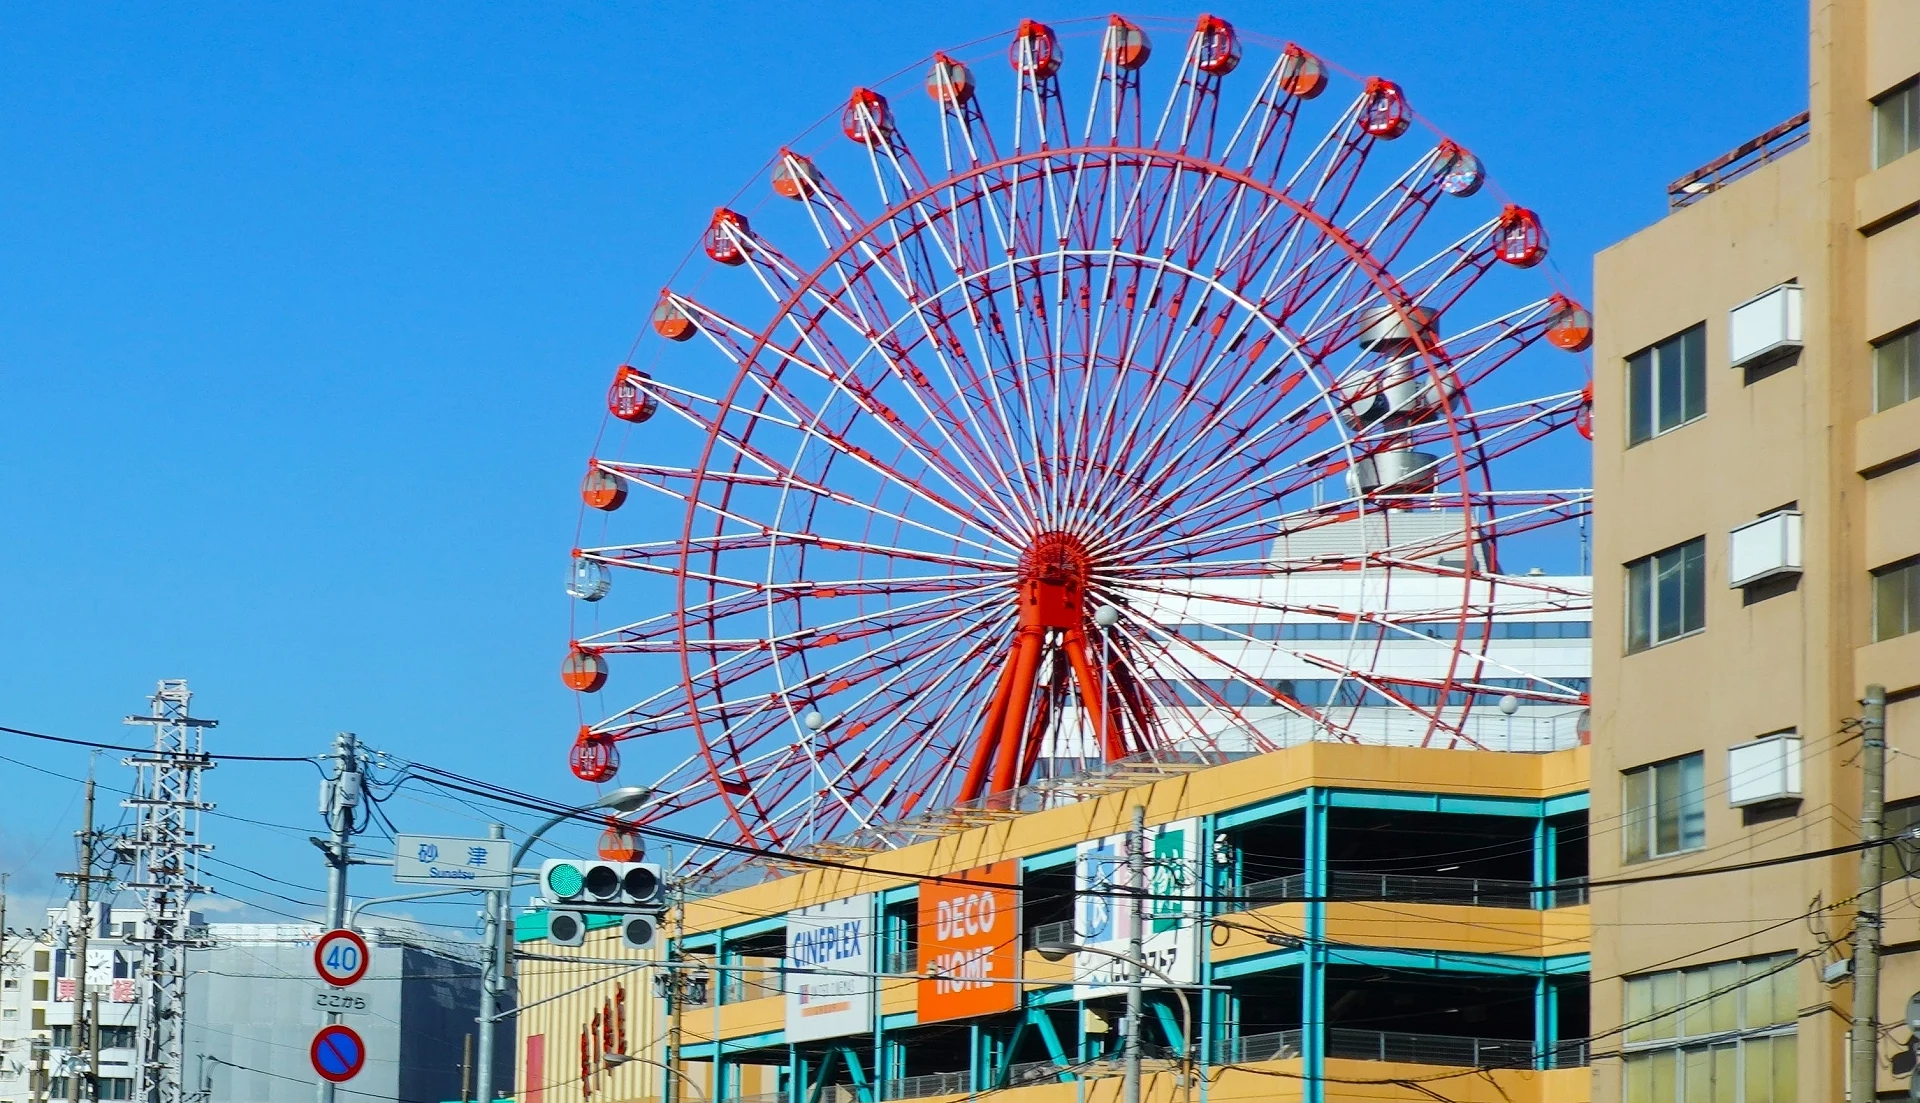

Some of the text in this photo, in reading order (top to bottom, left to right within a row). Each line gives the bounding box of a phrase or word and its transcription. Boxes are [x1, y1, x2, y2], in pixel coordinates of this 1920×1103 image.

[418, 844, 487, 867] 砂津
[937, 891, 995, 941] DECO
[327, 945, 357, 971] 40
[793, 920, 861, 968] CINEPLEX
[937, 946, 995, 995] HOME
[316, 994, 366, 1010] ここから
